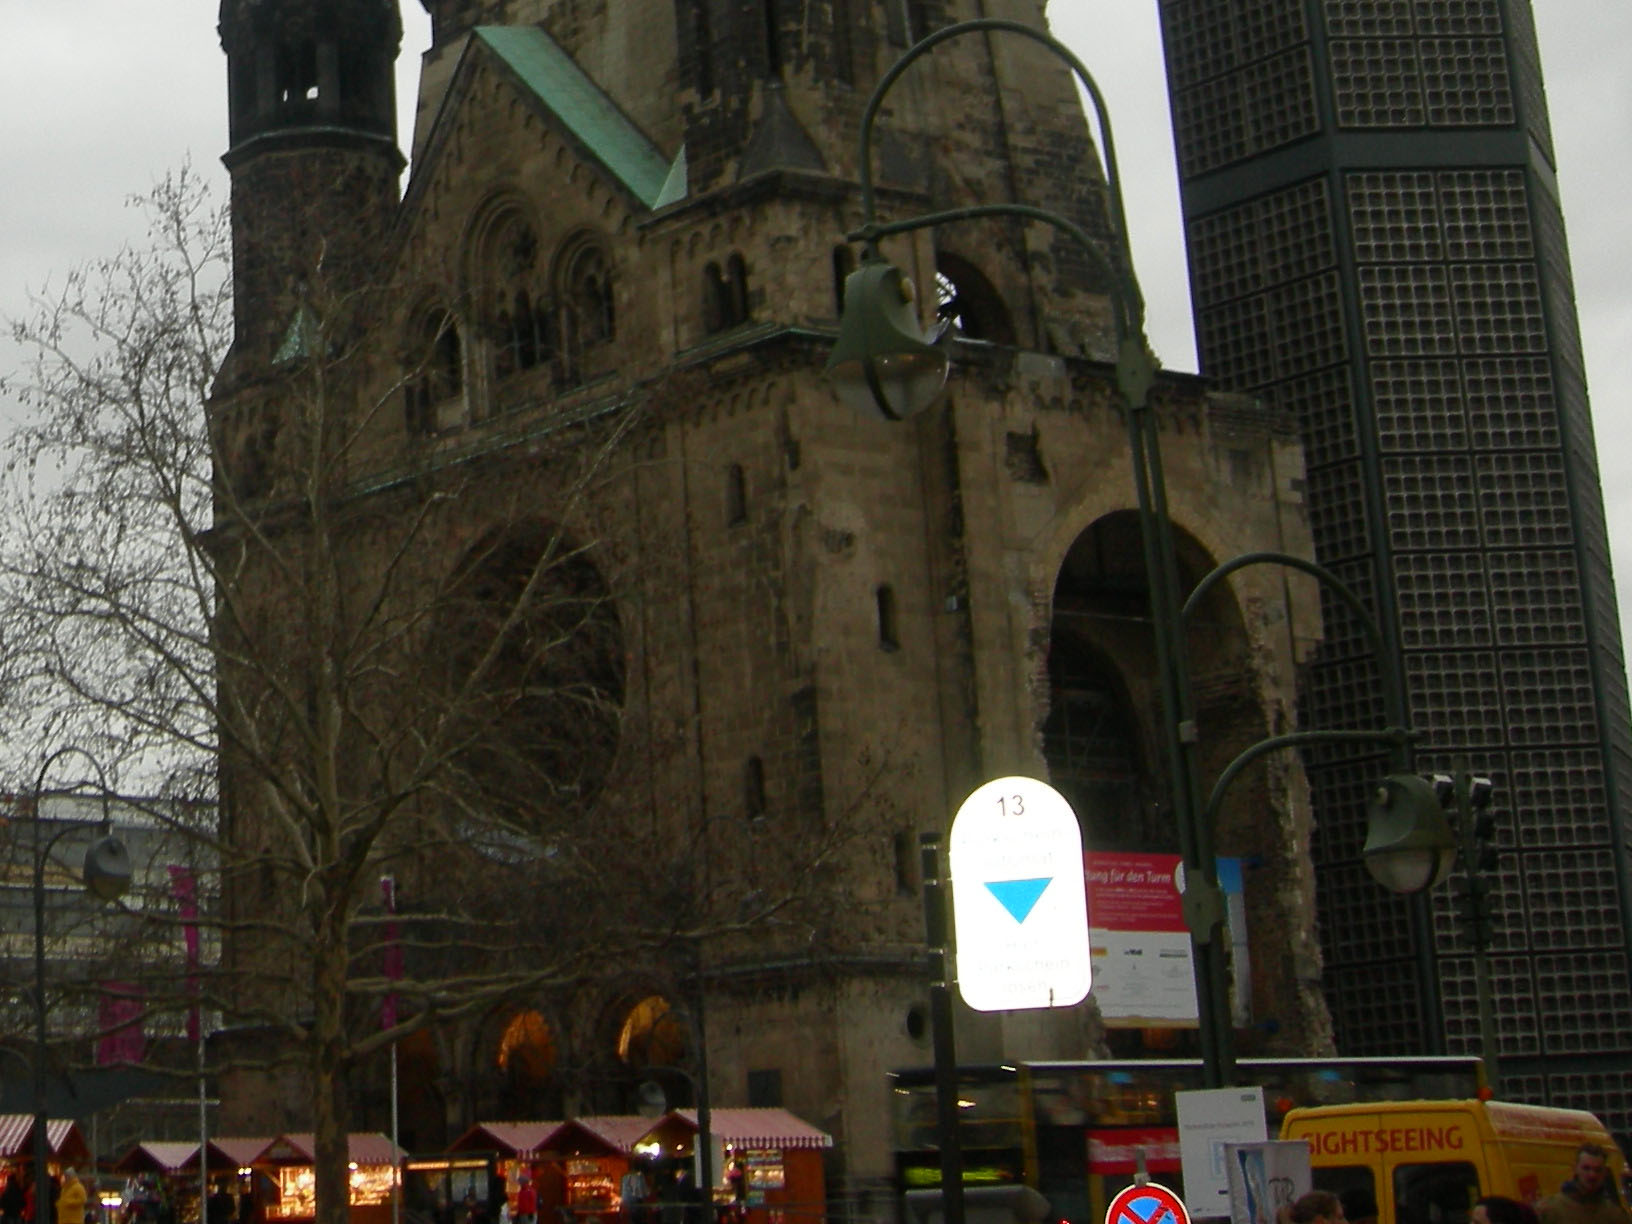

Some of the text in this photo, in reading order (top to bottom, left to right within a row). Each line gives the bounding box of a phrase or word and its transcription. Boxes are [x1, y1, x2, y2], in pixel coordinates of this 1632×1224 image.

[996, 793, 1026, 817] 13
[1146, 870, 1171, 884] Turm
[1300, 1125, 1464, 1155] SIGHTSEEING
